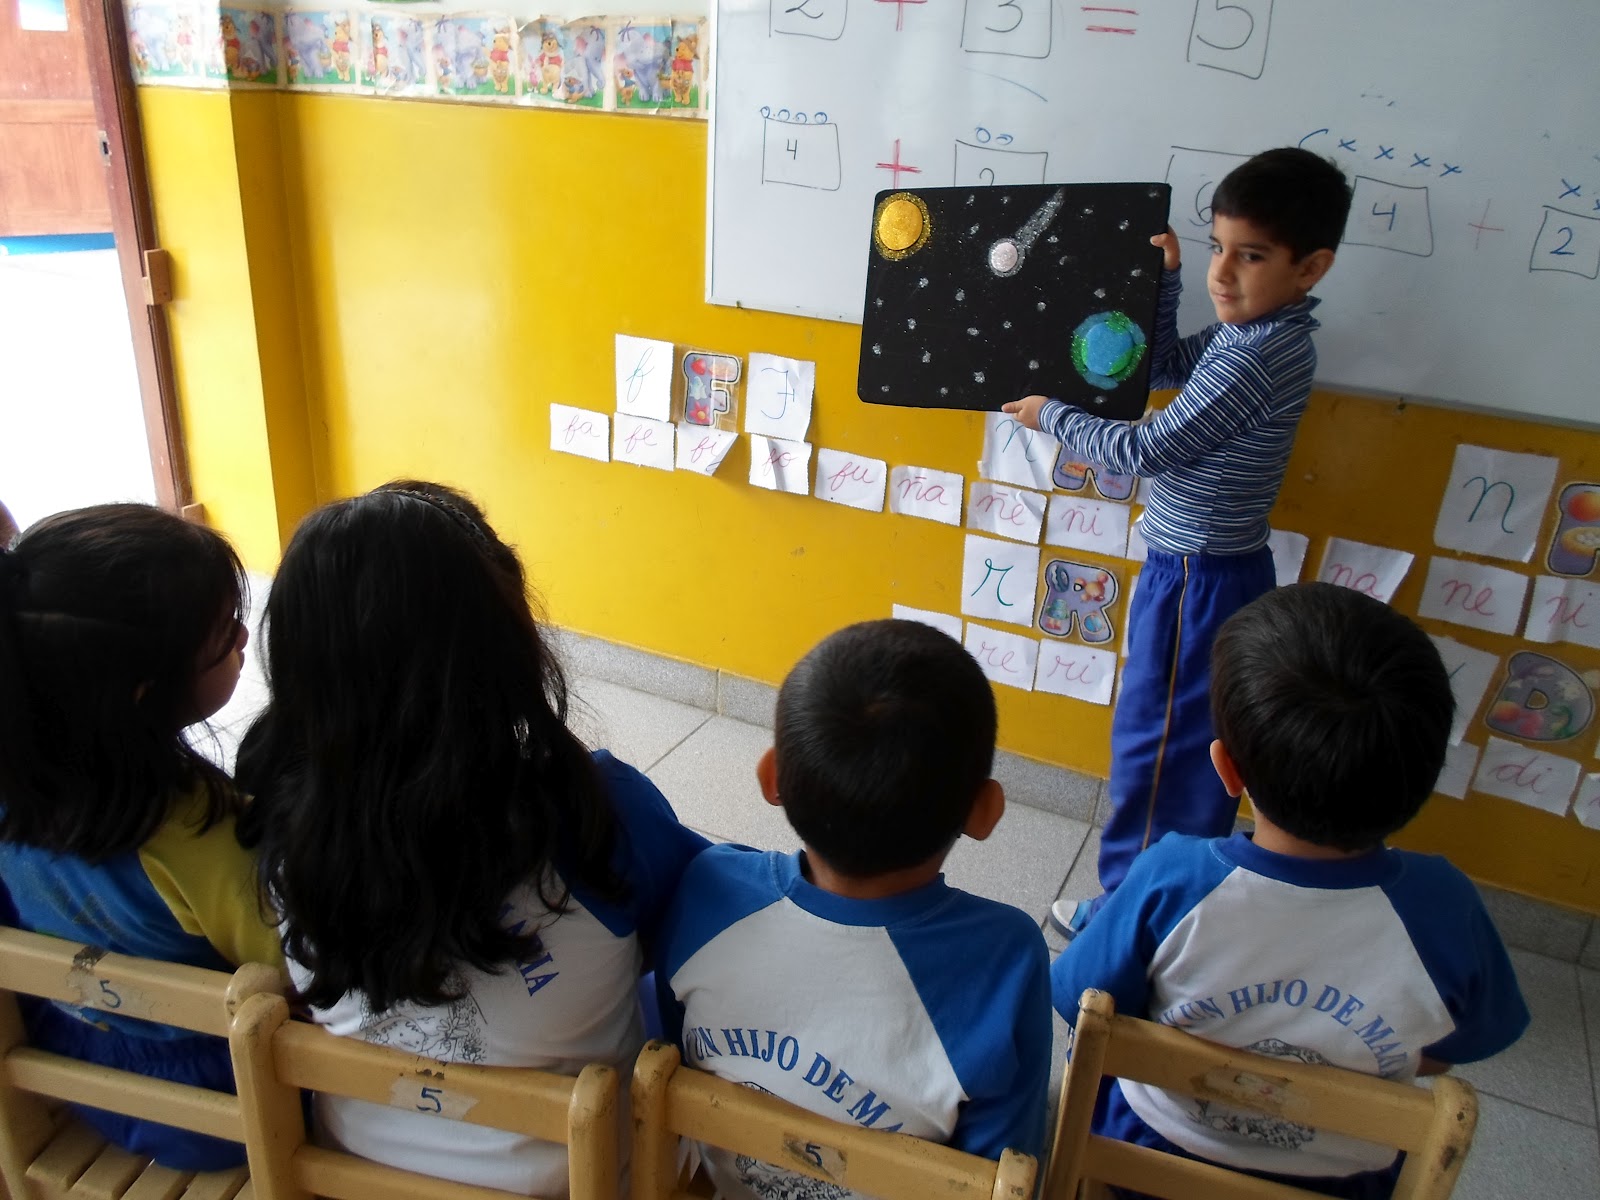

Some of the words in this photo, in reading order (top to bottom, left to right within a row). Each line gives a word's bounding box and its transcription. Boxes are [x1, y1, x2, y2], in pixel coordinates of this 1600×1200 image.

[1196, 0, 1254, 50] 5
[786, 138, 799, 161] 4
[1372, 202, 1396, 232] 4
[1549, 226, 1576, 256] 2
[563, 414, 601, 445] fa
[624, 424, 658, 454] fe
[827, 460, 875, 492] fu
[1463, 476, 1514, 534] n
[970, 558, 1015, 607] r
[1441, 578, 1495, 617] ne
[1047, 655, 1097, 685] ri
[1487, 755, 1553, 795] di
[99, 979, 122, 1009] 5
[1226, 978, 1310, 1015] HIJO
[1311, 984, 1366, 1028] DE
[720, 1027, 800, 1072] HIJO
[802, 1052, 855, 1104] DE
[416, 1086, 443, 1113] 5
[804, 1143, 824, 1168] 5
